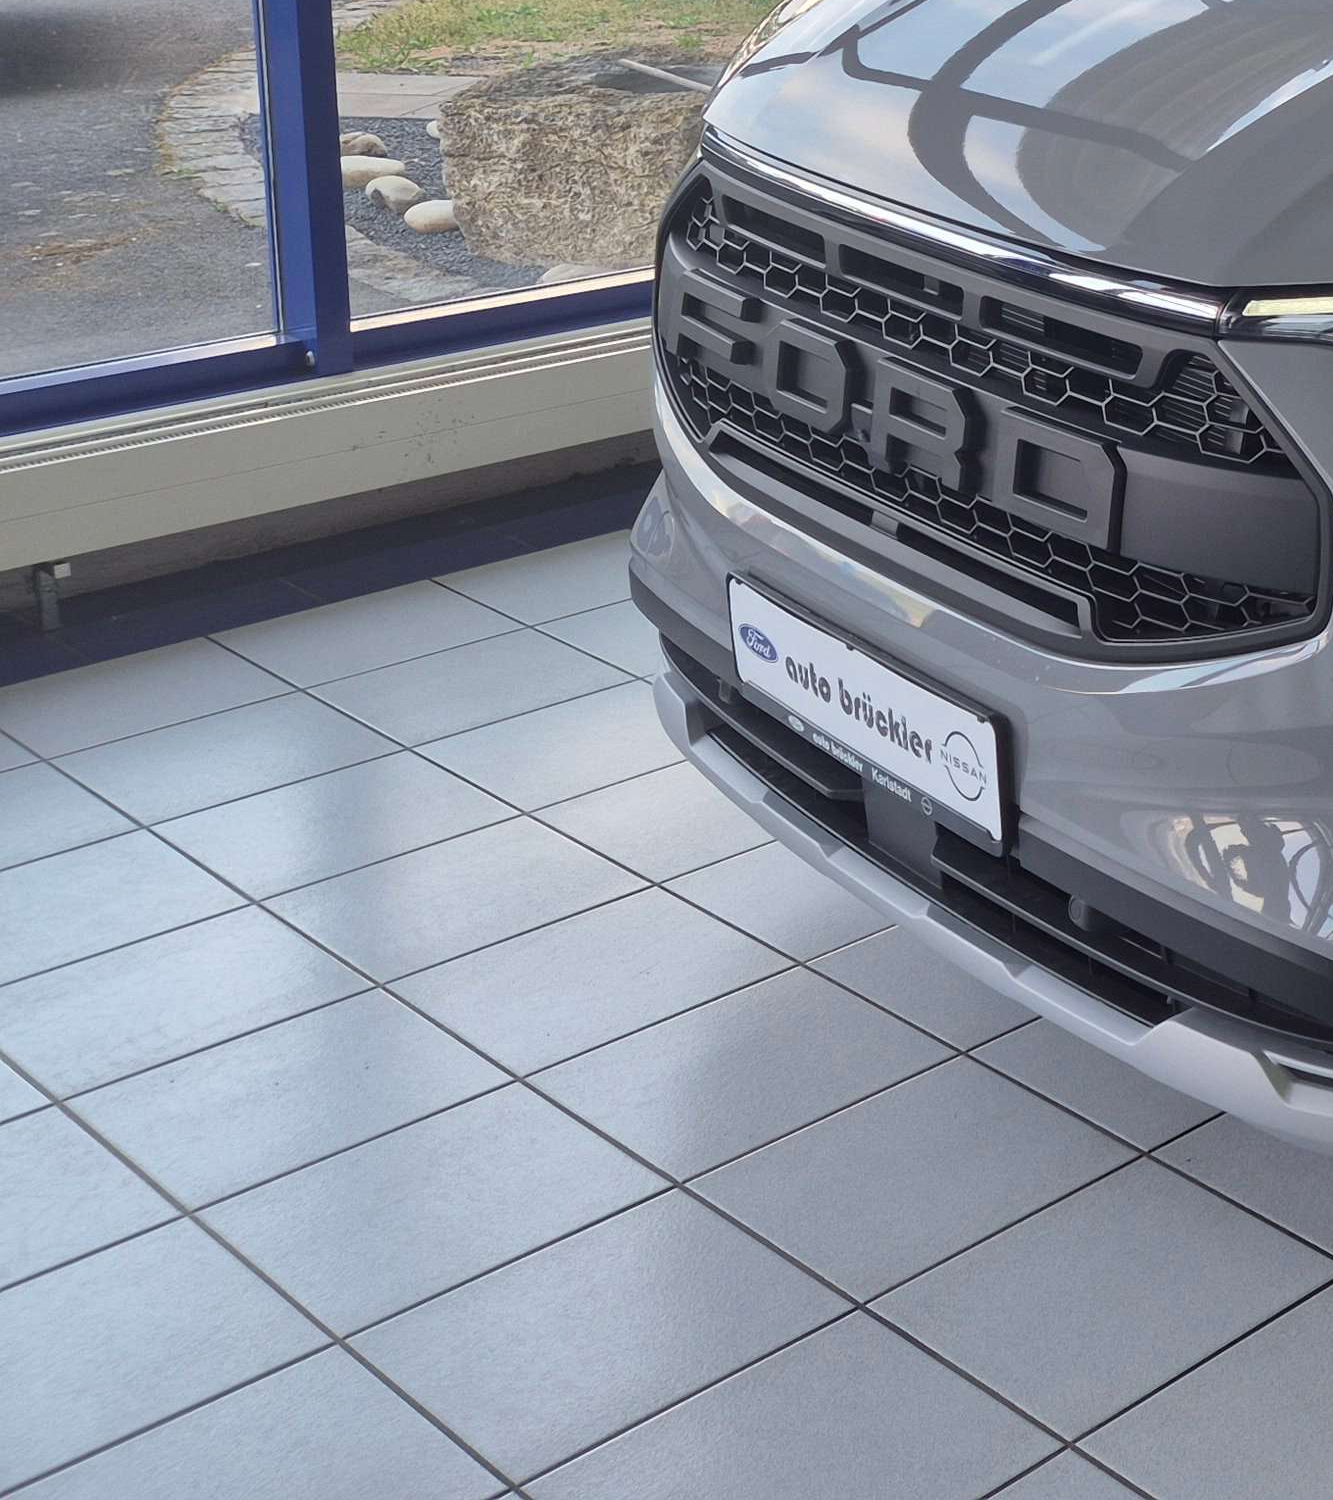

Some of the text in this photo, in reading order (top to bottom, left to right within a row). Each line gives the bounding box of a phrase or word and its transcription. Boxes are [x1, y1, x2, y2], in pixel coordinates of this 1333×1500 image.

[664, 268, 1124, 552] FORD
[746, 628, 772, 659] Ford
[785, 656, 933, 763] auto brückler
[871, 766, 912, 803] Karlstadt
[940, 749, 987, 784] NISSAN
